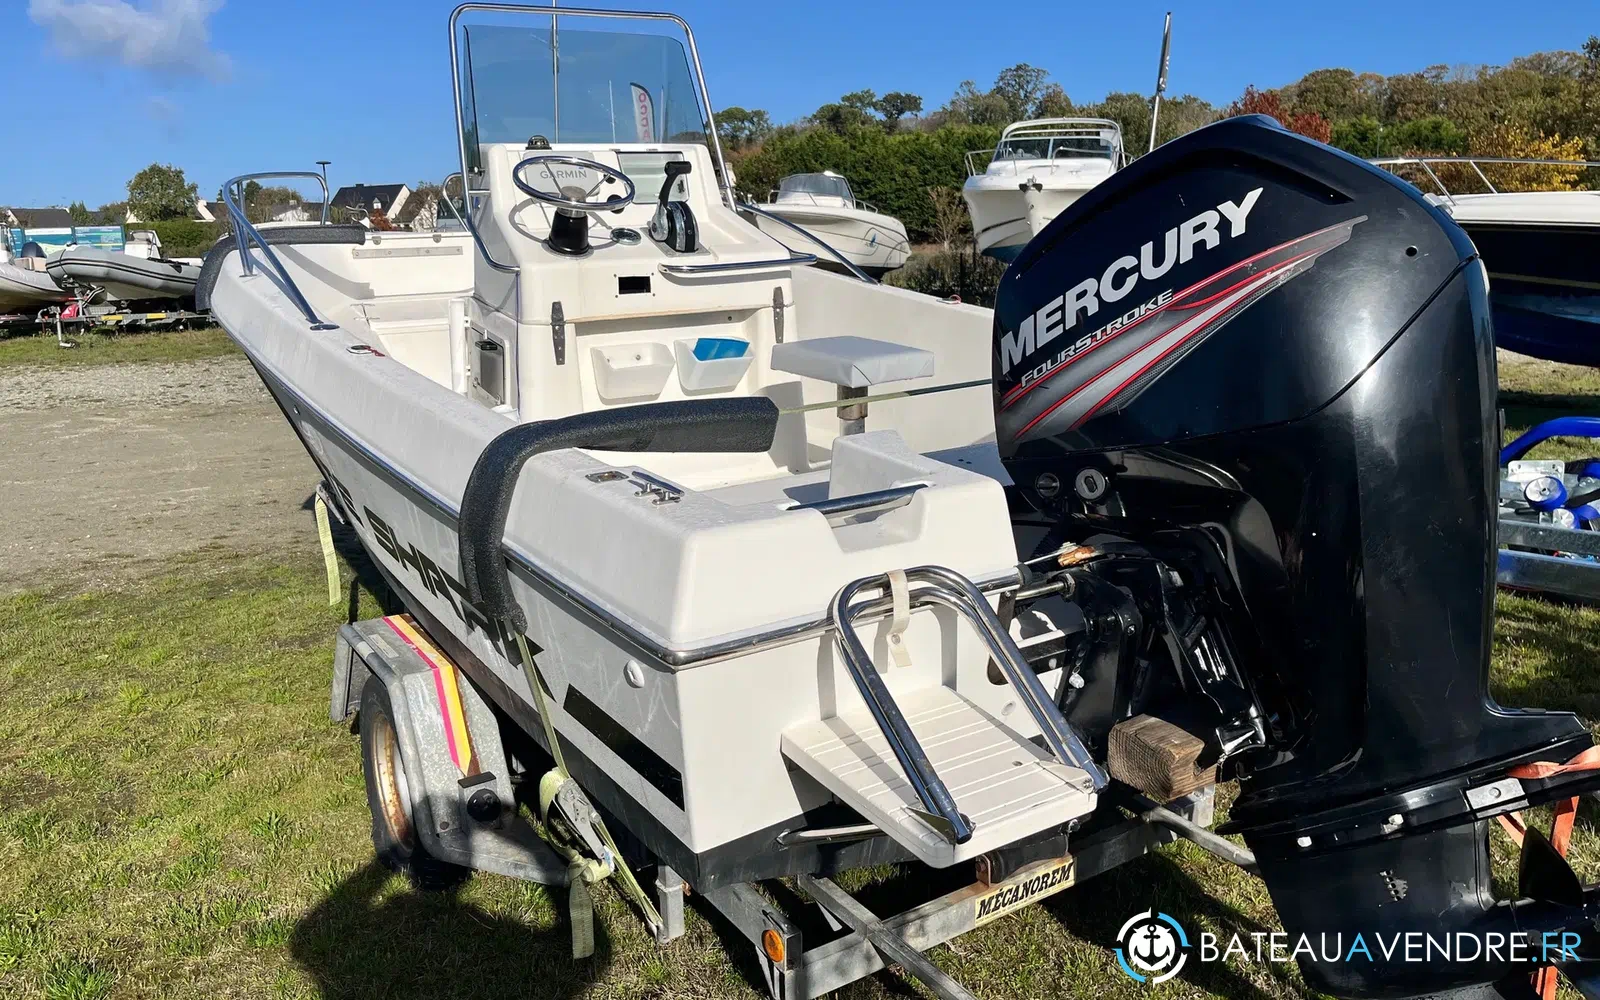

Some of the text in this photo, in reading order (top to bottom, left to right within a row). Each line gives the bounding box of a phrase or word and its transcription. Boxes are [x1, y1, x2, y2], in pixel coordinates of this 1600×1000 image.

[540, 170, 587, 179] GARMIN
[1001, 187, 1264, 375] MERCURY
[1020, 289, 1175, 388] FOURSTROKE
[976, 861, 1074, 919] MÉCANOREM
